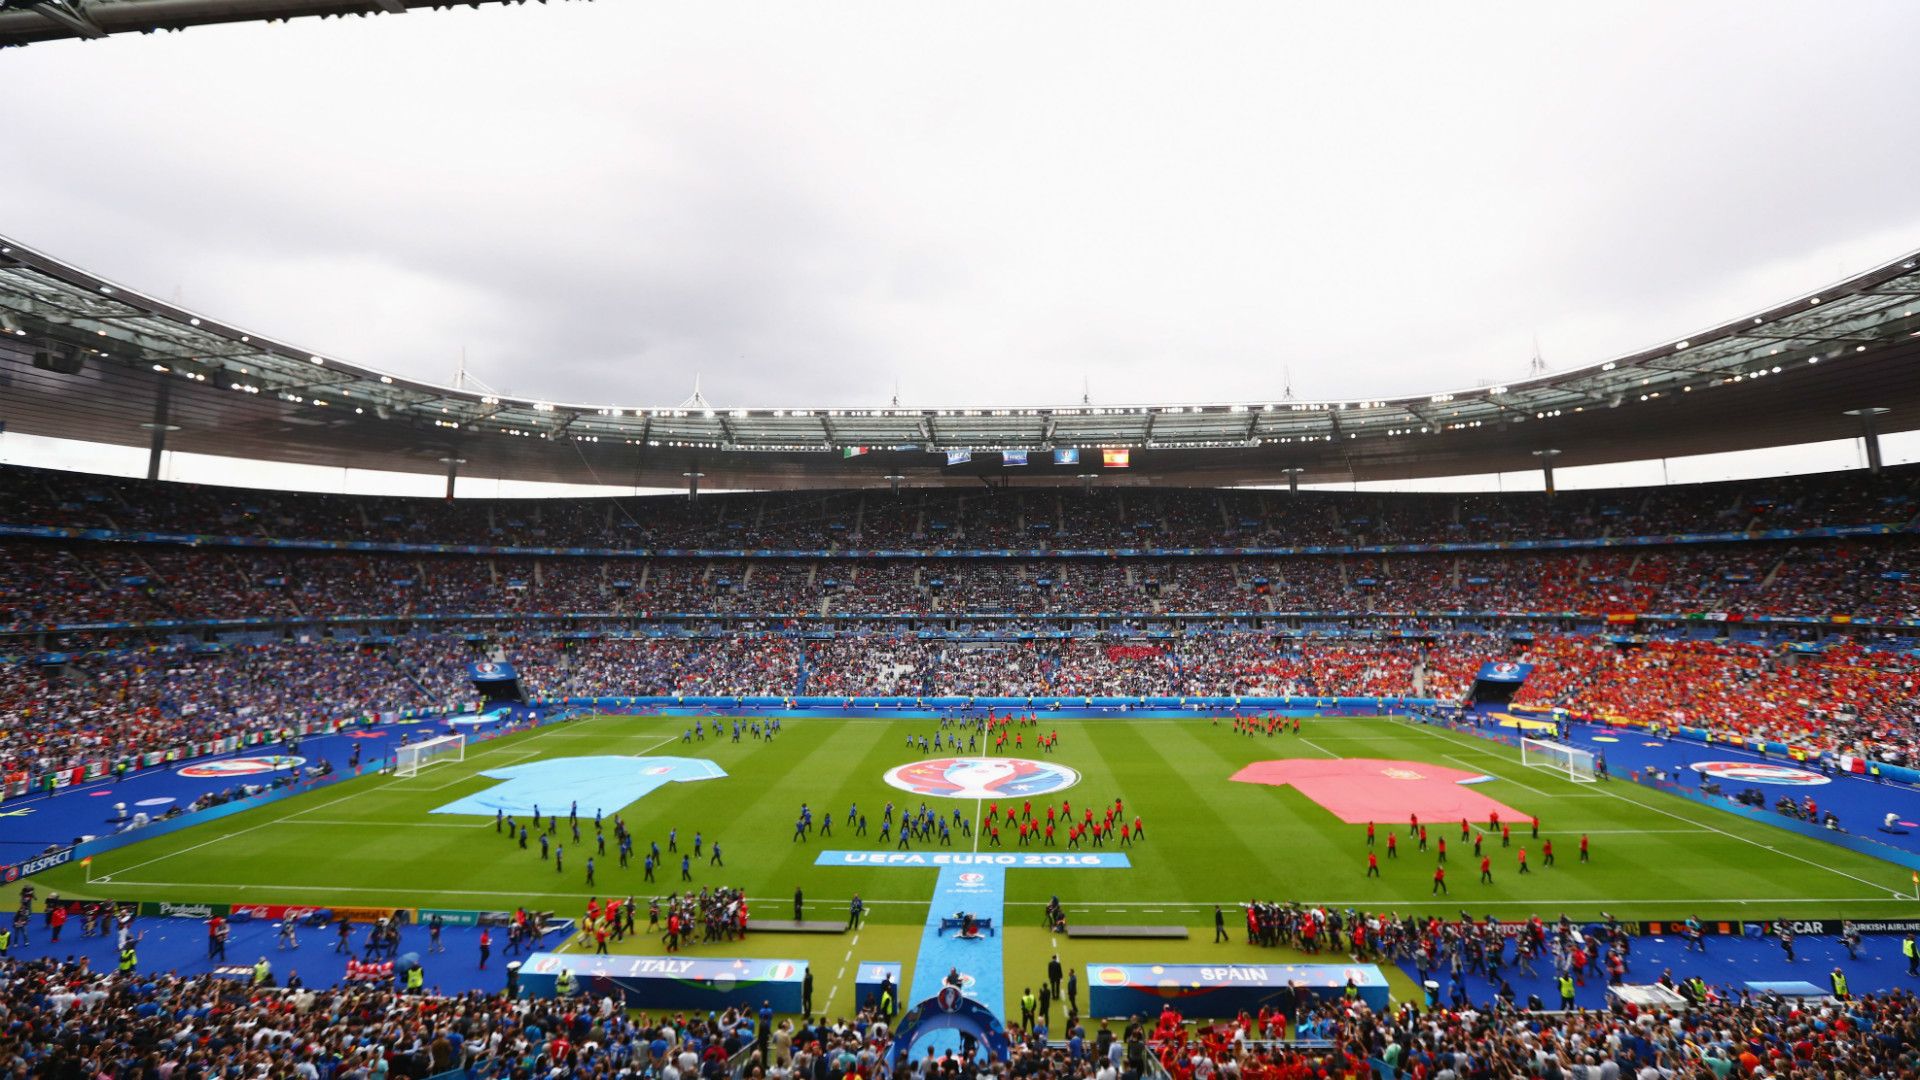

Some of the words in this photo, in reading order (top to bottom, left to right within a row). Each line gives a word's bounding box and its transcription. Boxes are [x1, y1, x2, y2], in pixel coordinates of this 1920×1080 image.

[22, 849, 73, 876] RESPECT
[844, 854, 925, 863] UEFA
[933, 854, 1017, 864] EURO
[1024, 855, 1101, 864] 2016
[159, 902, 212, 917] Probably
[1772, 921, 1824, 934] SCAR
[630, 959, 695, 974] ITALY
[1200, 966, 1268, 981] SPAIN
